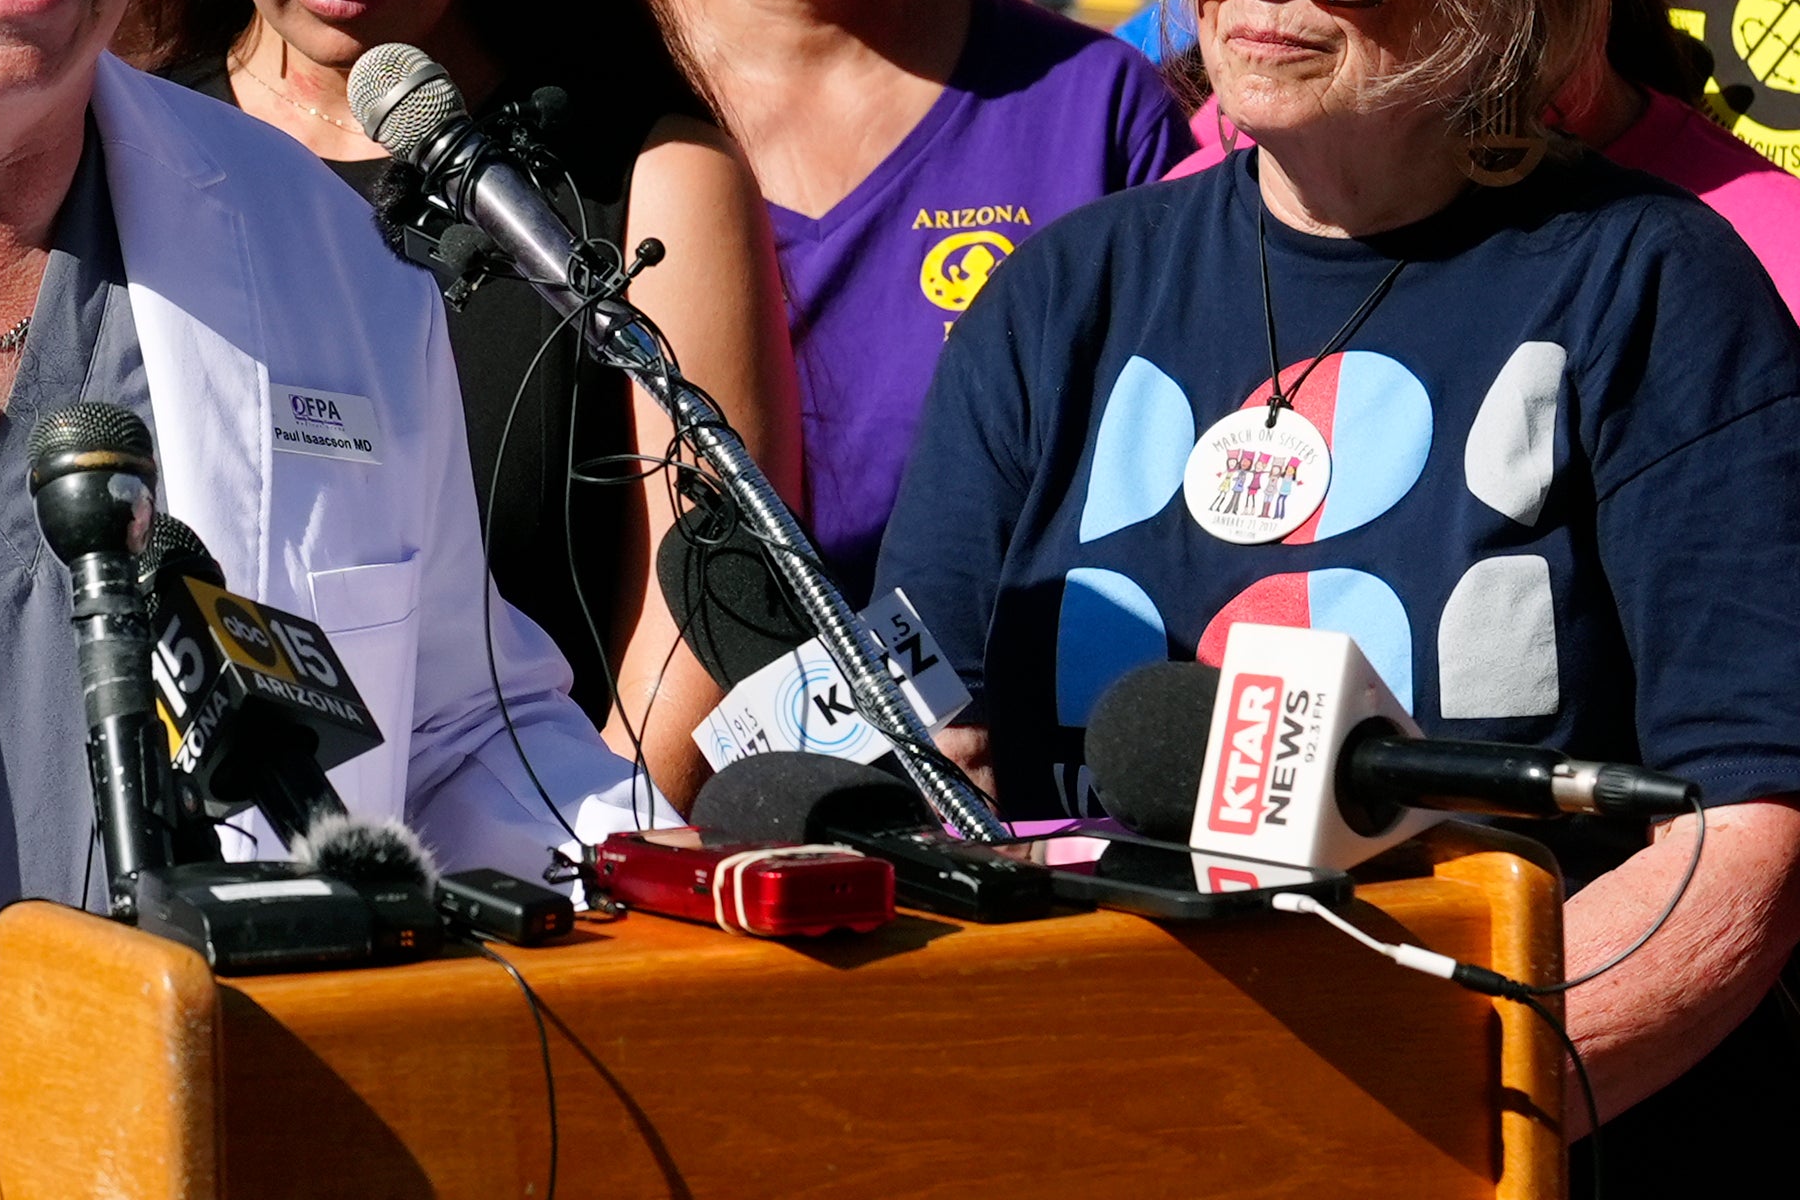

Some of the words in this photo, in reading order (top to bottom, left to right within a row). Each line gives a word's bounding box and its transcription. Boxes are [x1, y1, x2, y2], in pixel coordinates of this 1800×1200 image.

[911, 204, 1033, 230] ARIZONA
[274, 427, 300, 443] Paul
[302, 430, 352, 450] Isaacson
[353, 438, 373, 452] MD
[1212, 429, 1252, 453] MARCH
[1258, 428, 1274, 442] ON
[1280, 431, 1319, 465] SISTERS
[222, 615, 270, 649] abc
[269, 619, 339, 687] 15
[151, 614, 205, 718] 15
[253, 672, 364, 726] ARIZONA
[733, 707, 758, 738] 91.5
[1304, 724, 1321, 763] 92.3
[1313, 692, 1326, 719] FM
[172, 689, 229, 774] ZONA
[1217, 684, 1277, 824] KTAR
[1264, 689, 1310, 826] NEWS
